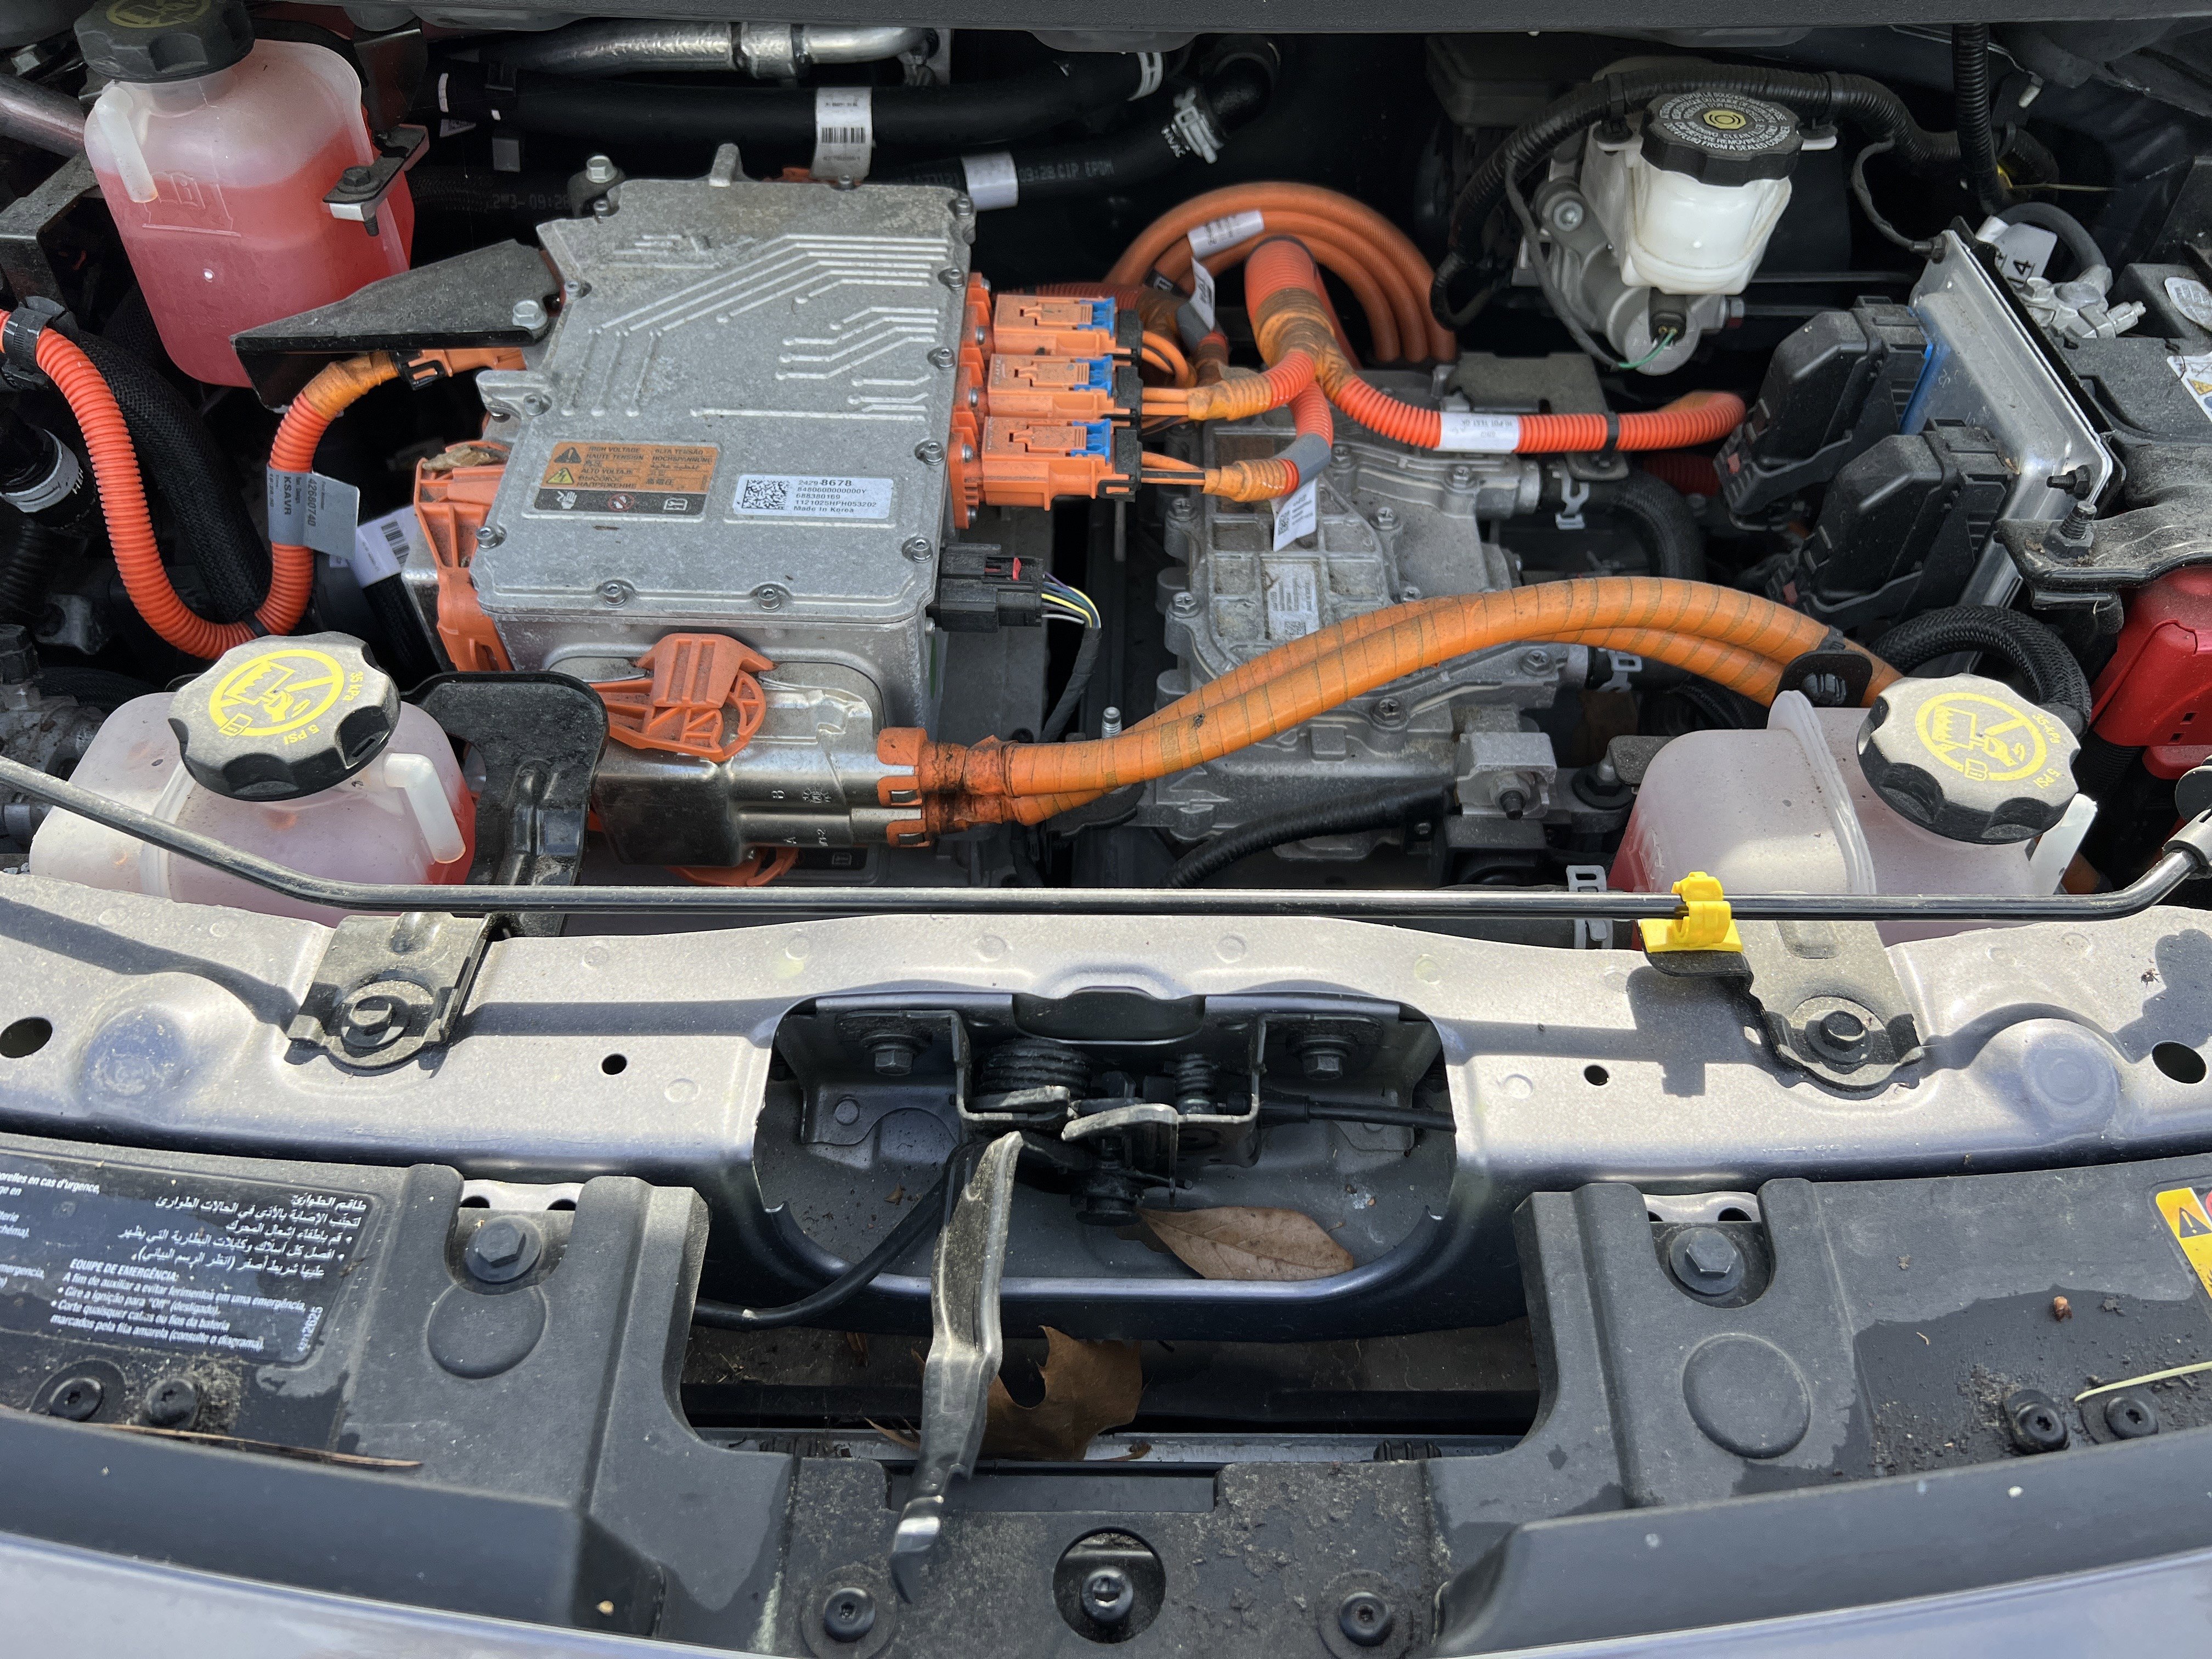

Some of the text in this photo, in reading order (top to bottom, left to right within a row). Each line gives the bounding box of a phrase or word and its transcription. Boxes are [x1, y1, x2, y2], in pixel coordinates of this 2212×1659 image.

[1701, 140, 1728, 150] FROM
[284, 475, 292, 515] KSAVR
[342, 671, 364, 701] 35 kPa
[2032, 714, 2050, 726] 35
[283, 724, 320, 745] 5 PSI
[2033, 768, 2061, 789] 5 PSI
[10, 1187, 22, 1197] en
[27, 1175, 40, 1186] en
[40, 1177, 57, 1188] cas
[57, 1178, 100, 1195] d'urgence,
[70, 1258, 105, 1273] EQUIPE
[103, 1262, 119, 1274] DE
[62, 1271, 72, 1283] A
[71, 1272, 88, 1285] fim
[87, 1276, 101, 1286] de
[100, 1277, 135, 1291] auxiliar
[133, 1282, 142, 1293] a
[142, 1283, 168, 1295] evitar
[168, 1285, 216, 1301] ferimentos
[215, 1293, 231, 1303] em
[230, 1294, 252, 1306] uma
[64, 1285, 84, 1298] Gire
[83, 1290, 92, 1300] a
[124, 1296, 146, 1308] para
[58, 1299, 231, 1333] Corte quaisquer cabos ou fios da bateria
[50, 1314, 95, 1330] marcados
[94, 1321, 116, 1333] pela
[116, 1321, 133, 1335] fita
[132, 1326, 170, 1340] amarela
[168, 1328, 211, 1345] (consulte
[210, 1335, 218, 1345] o
